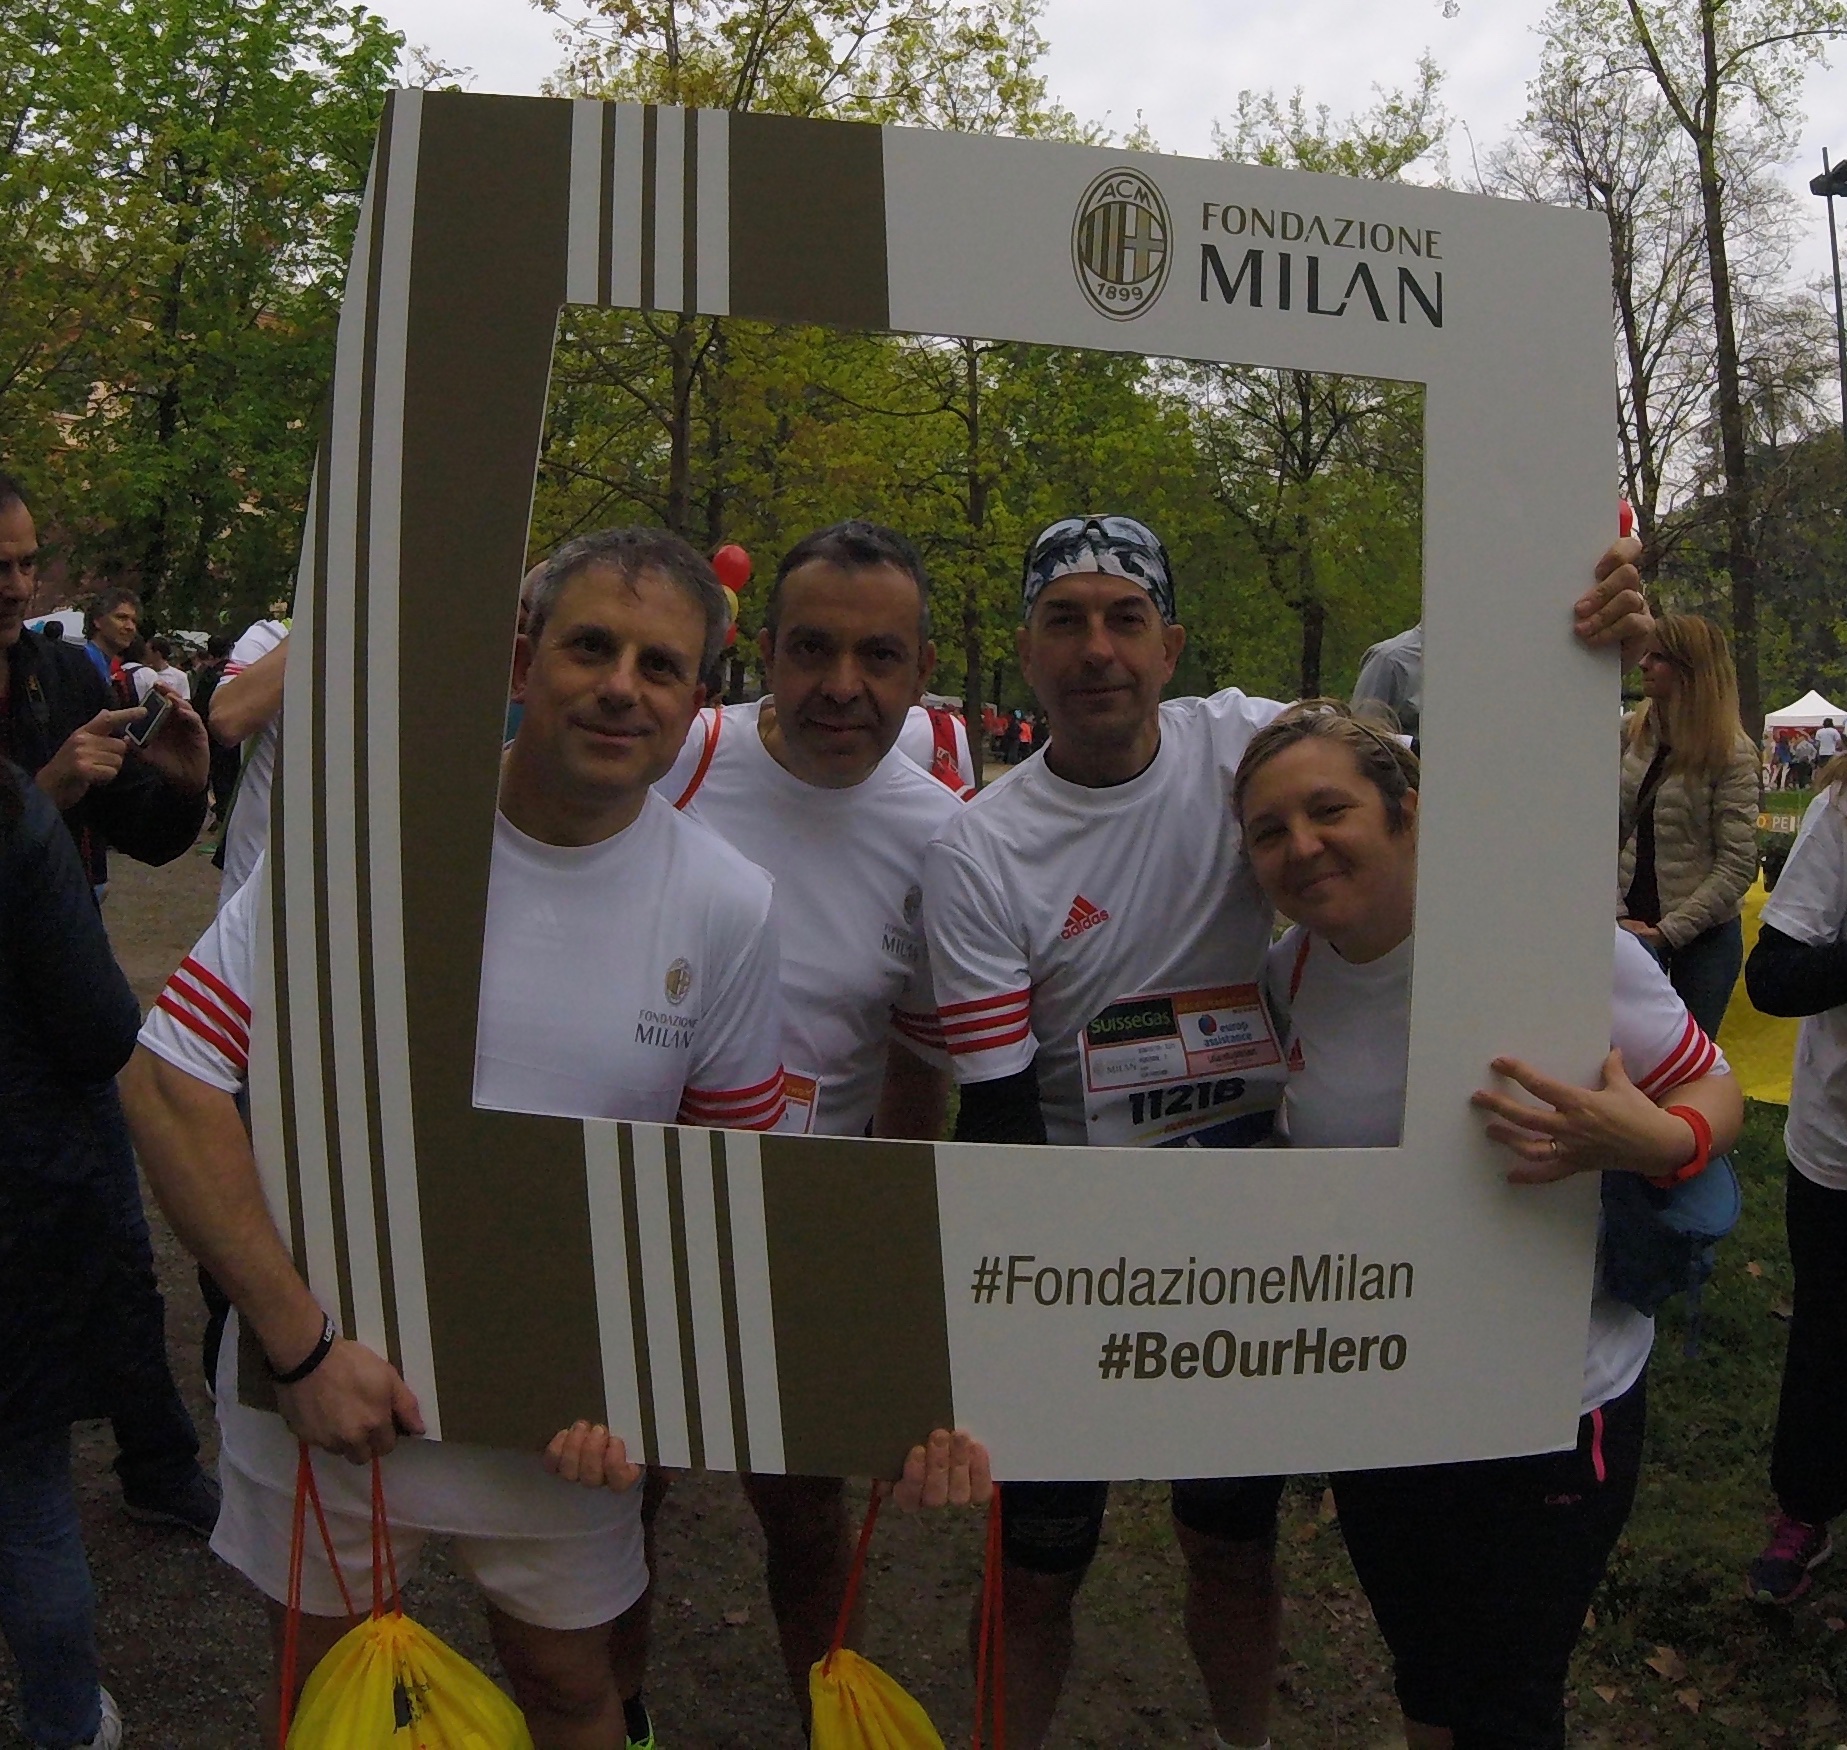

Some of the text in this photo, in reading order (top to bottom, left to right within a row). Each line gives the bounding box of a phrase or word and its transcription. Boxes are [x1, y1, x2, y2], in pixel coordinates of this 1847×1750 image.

[1097, 179, 1153, 210] ACM
[1202, 202, 1443, 260] FONDAZIONE
[1097, 281, 1144, 302] 1899
[1200, 243, 1443, 328] MILAN
[1061, 909, 1109, 940] adidas
[638, 1009, 698, 1029] FONDAZIONE
[634, 1022, 695, 1049] MILAN
[971, 1253, 1414, 1306] #FondazioneMilan
[1098, 1327, 1408, 1380] #BeOurHero
